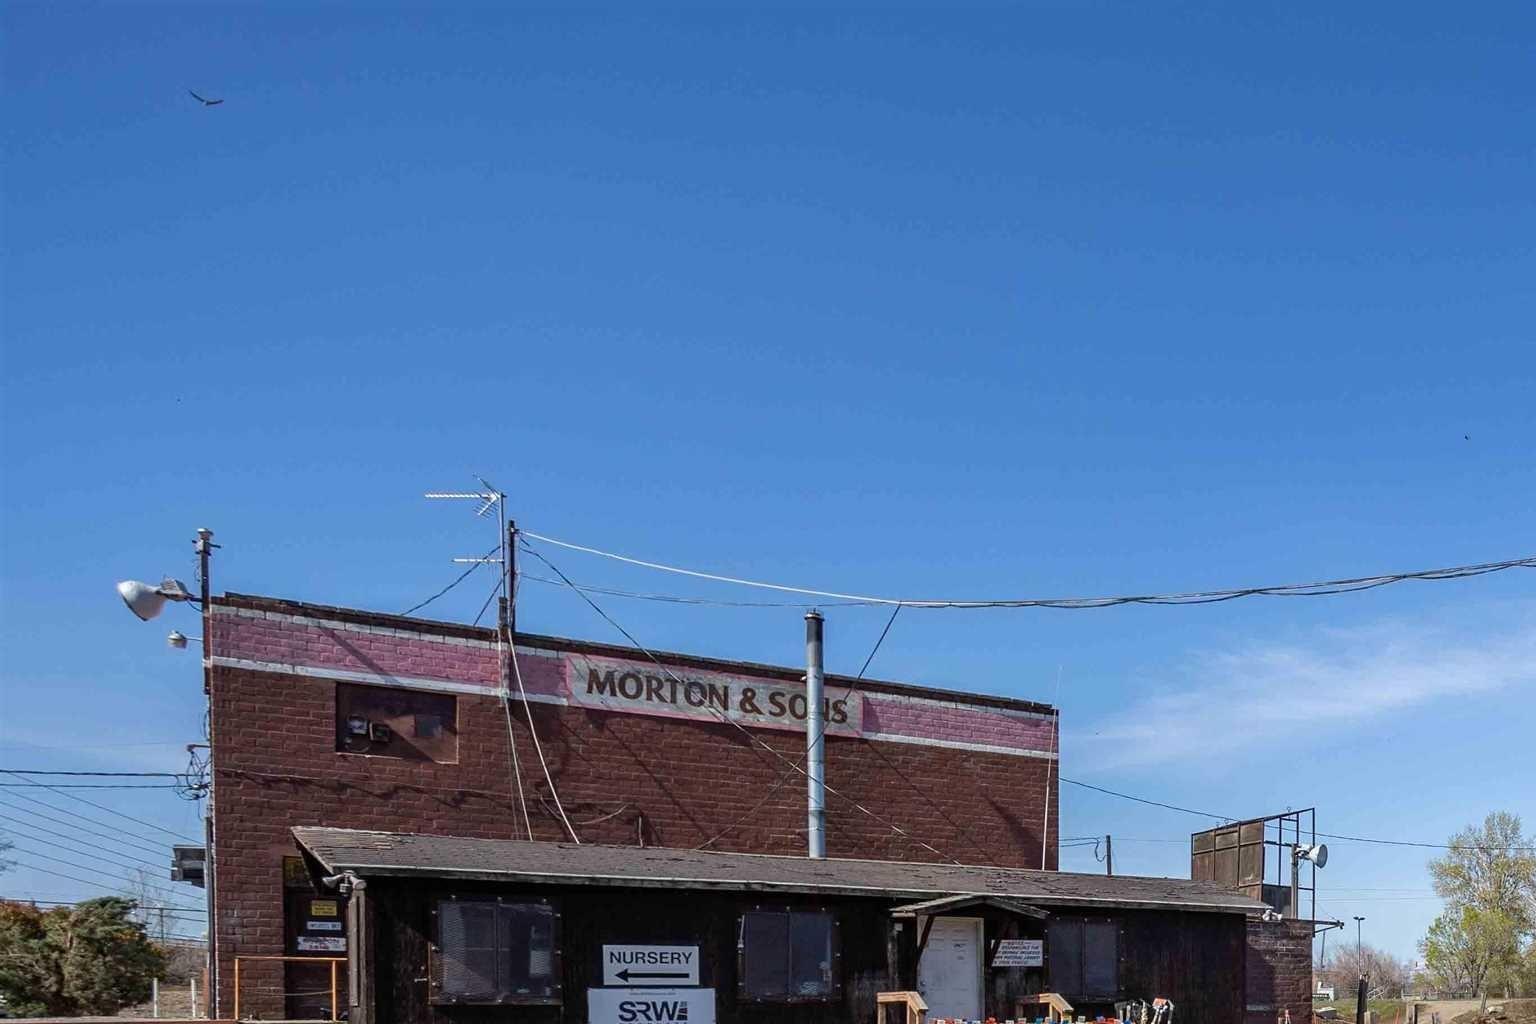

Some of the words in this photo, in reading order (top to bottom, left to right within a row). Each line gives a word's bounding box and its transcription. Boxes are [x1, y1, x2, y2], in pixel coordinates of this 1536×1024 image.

[586, 668, 729, 711] MORTON
[739, 687, 765, 715] &
[768, 691, 849, 724] SOS
[609, 951, 693, 965] NURSERY
[618, 1000, 679, 1022] SRW
